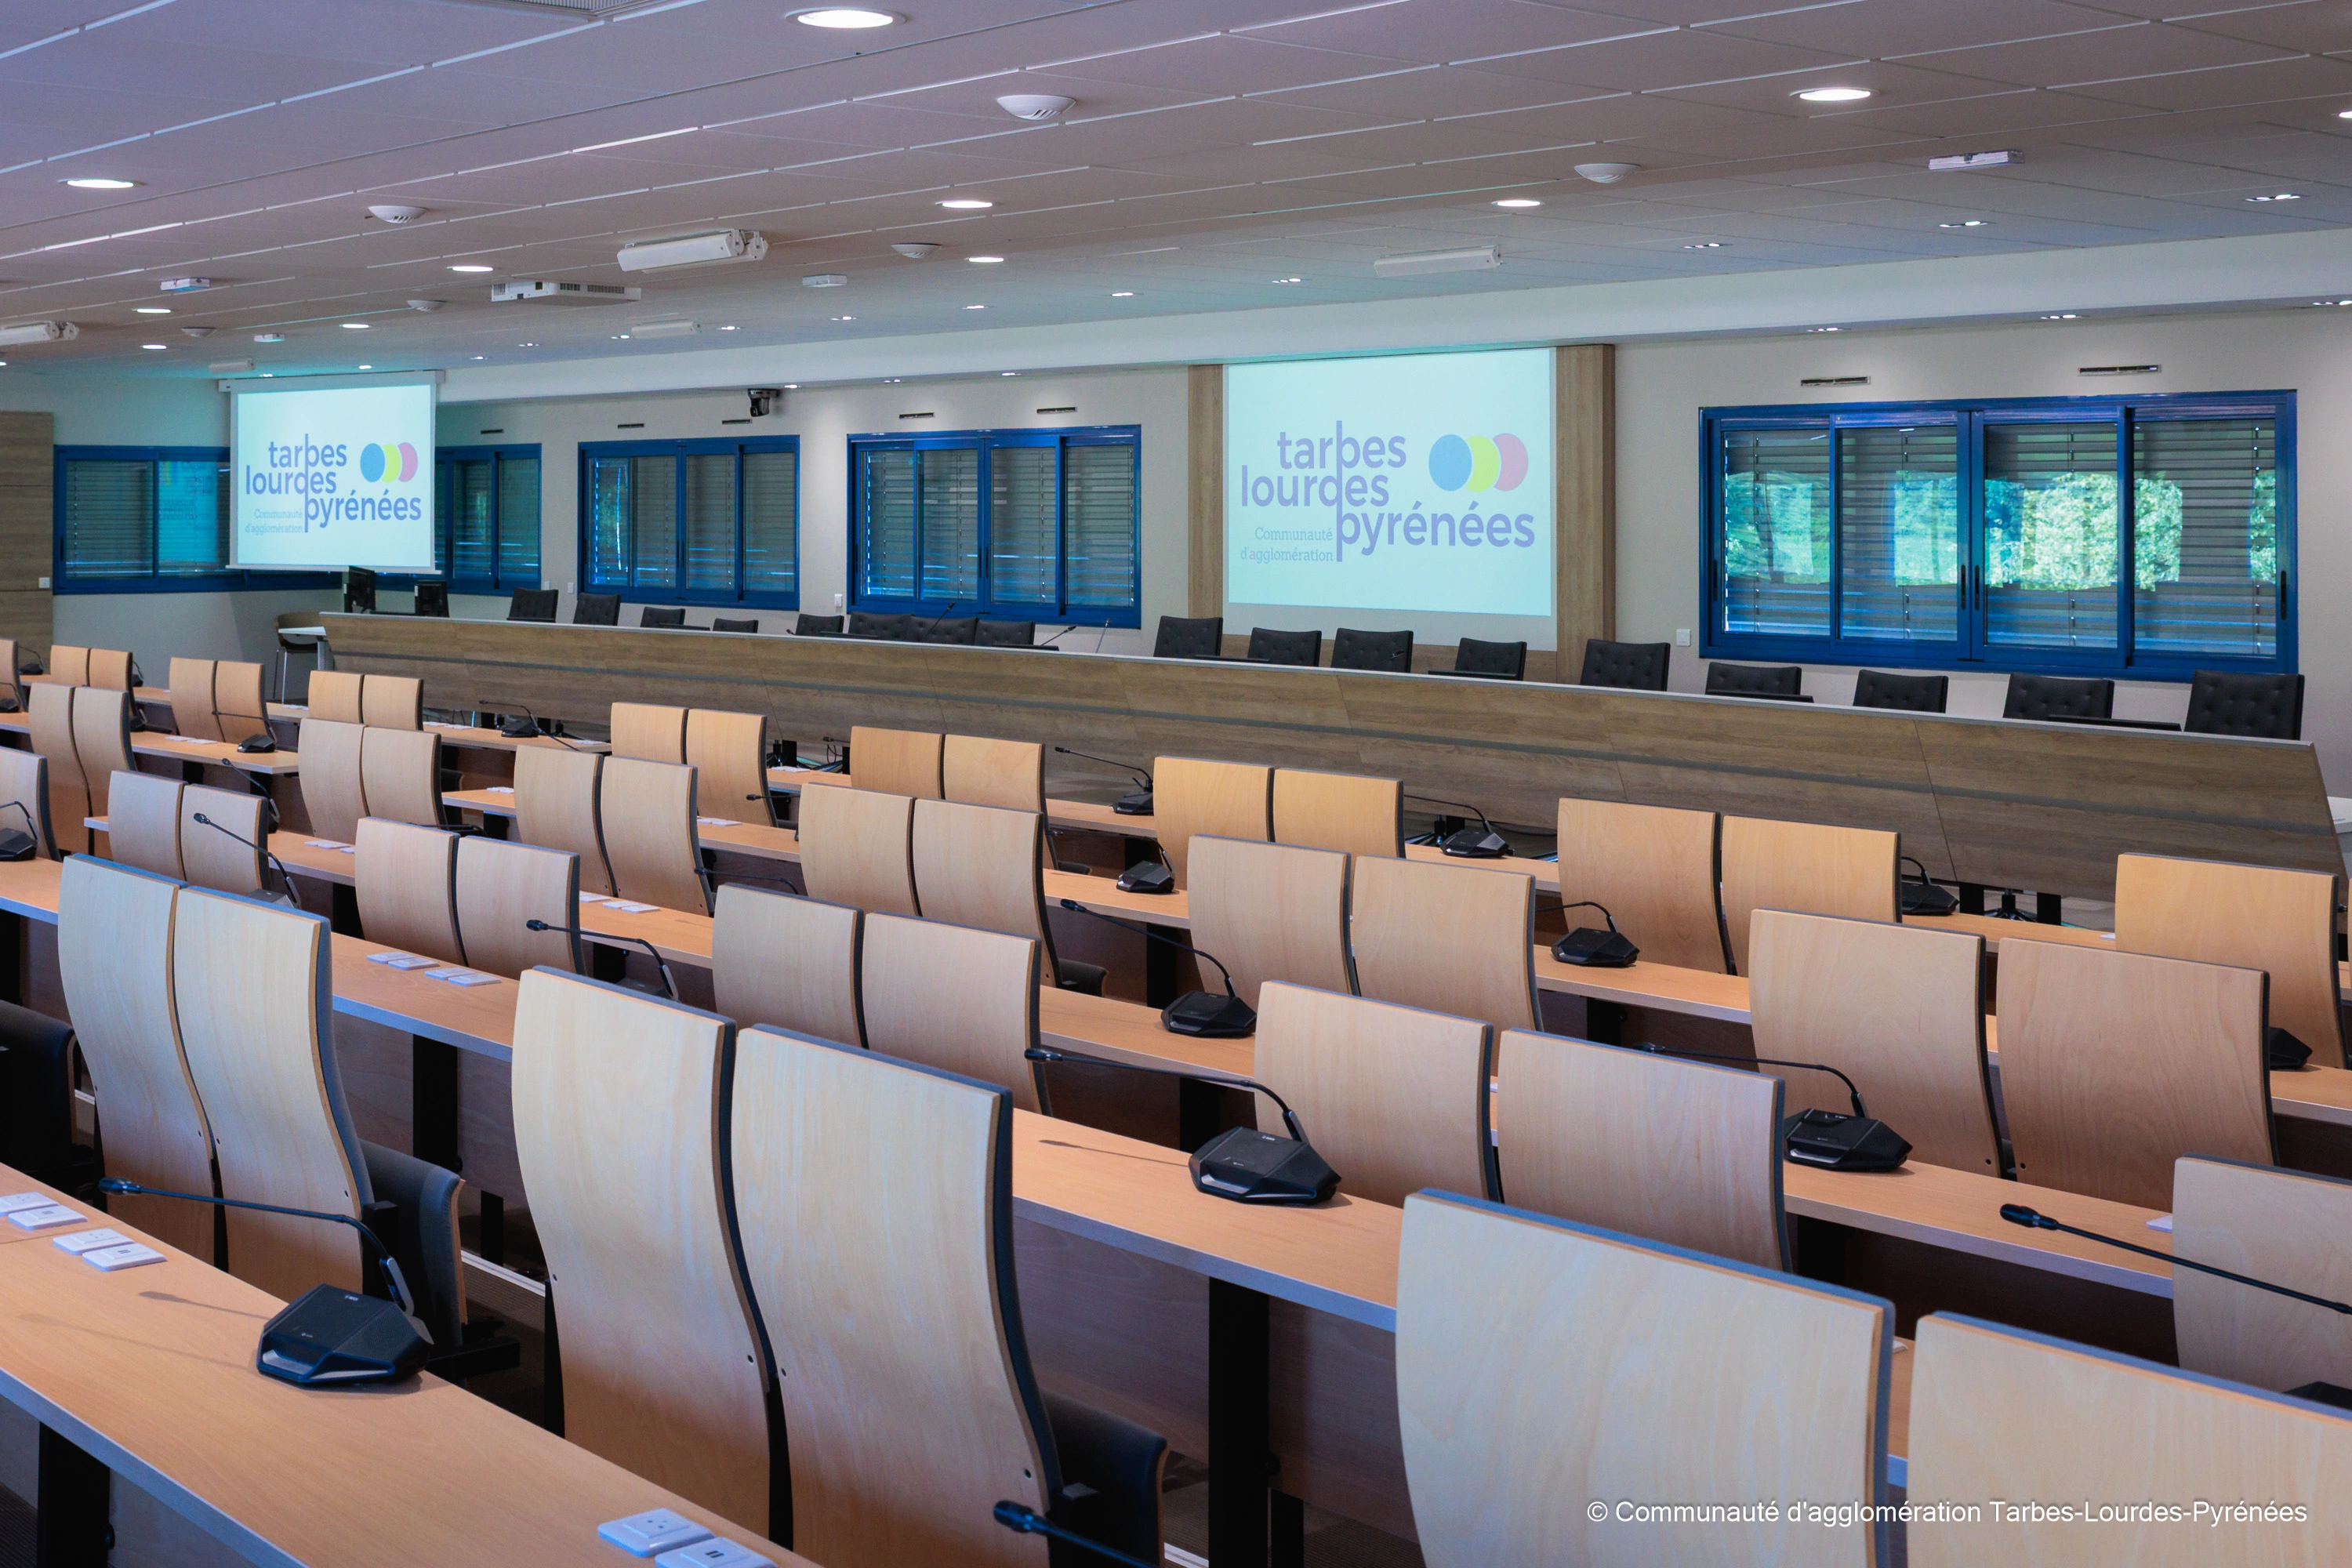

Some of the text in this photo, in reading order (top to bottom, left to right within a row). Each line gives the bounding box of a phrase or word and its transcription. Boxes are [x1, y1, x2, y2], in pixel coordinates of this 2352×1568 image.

[268, 434, 347, 469] tarbes
[1277, 420, 1407, 470] tarbes
[245, 465, 337, 495] lourdes
[1241, 465, 1389, 507] lourdes
[254, 508, 303, 520] Communauté
[303, 488, 422, 533] pyrénées
[245, 523, 303, 536] d'agglomération
[1254, 527, 1333, 542] Communauté
[1336, 500, 1536, 562] pyrénées
[1240, 546, 1334, 564] d'agglomération
